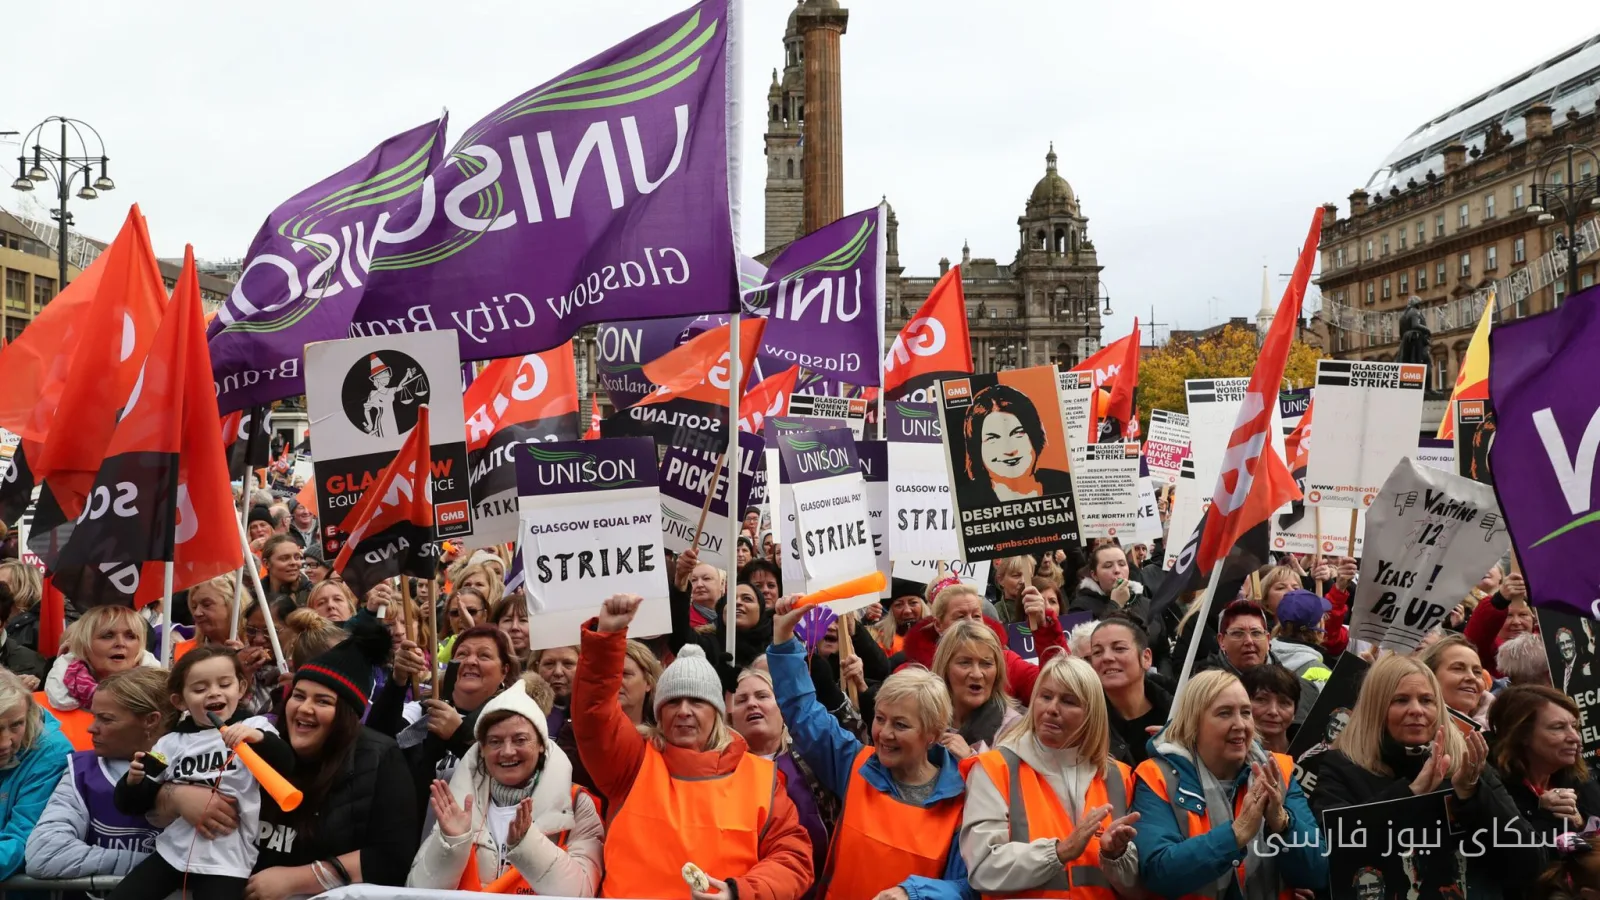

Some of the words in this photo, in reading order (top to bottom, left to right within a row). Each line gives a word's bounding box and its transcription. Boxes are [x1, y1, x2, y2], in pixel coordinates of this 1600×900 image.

[1351, 370, 1399, 379] WOMEN'S
[1352, 363, 1399, 372] GLASGOW
[1403, 372, 1421, 380] GMB
[948, 387, 968, 396] GMB
[1350, 378, 1398, 389] STRIKE
[814, 396, 848, 405] GLASGOW
[814, 403, 848, 411] WOMEN'S
[813, 409, 848, 419] STRIKE
[1147, 450, 1173, 460] MAKE
[1148, 441, 1182, 454] WOMEN
[797, 448, 849, 474] UNISON
[538, 459, 636, 486] UNISON
[895, 484, 936, 493] GLASGOW
[800, 498, 831, 512] GLASGOW
[831, 495, 851, 507] EQUAL
[852, 493, 861, 503] PAY
[962, 496, 1070, 523] DESPERATELY
[441, 510, 465, 521] GMB
[530, 520, 590, 535] GLASGOW
[593, 517, 630, 530] EQUAL
[633, 514, 653, 526] PAY
[897, 509, 955, 531] STRI
[965, 519, 1025, 536] SEEKING
[1029, 511, 1074, 527] SUSAN
[805, 520, 867, 557] STRIKE
[968, 532, 1078, 553] www.gmbscotland.org
[1418, 523, 1444, 546] 12
[536, 544, 655, 584] STRIKE
[174, 750, 237, 778] EQUAL
[259, 820, 298, 853] PAY
